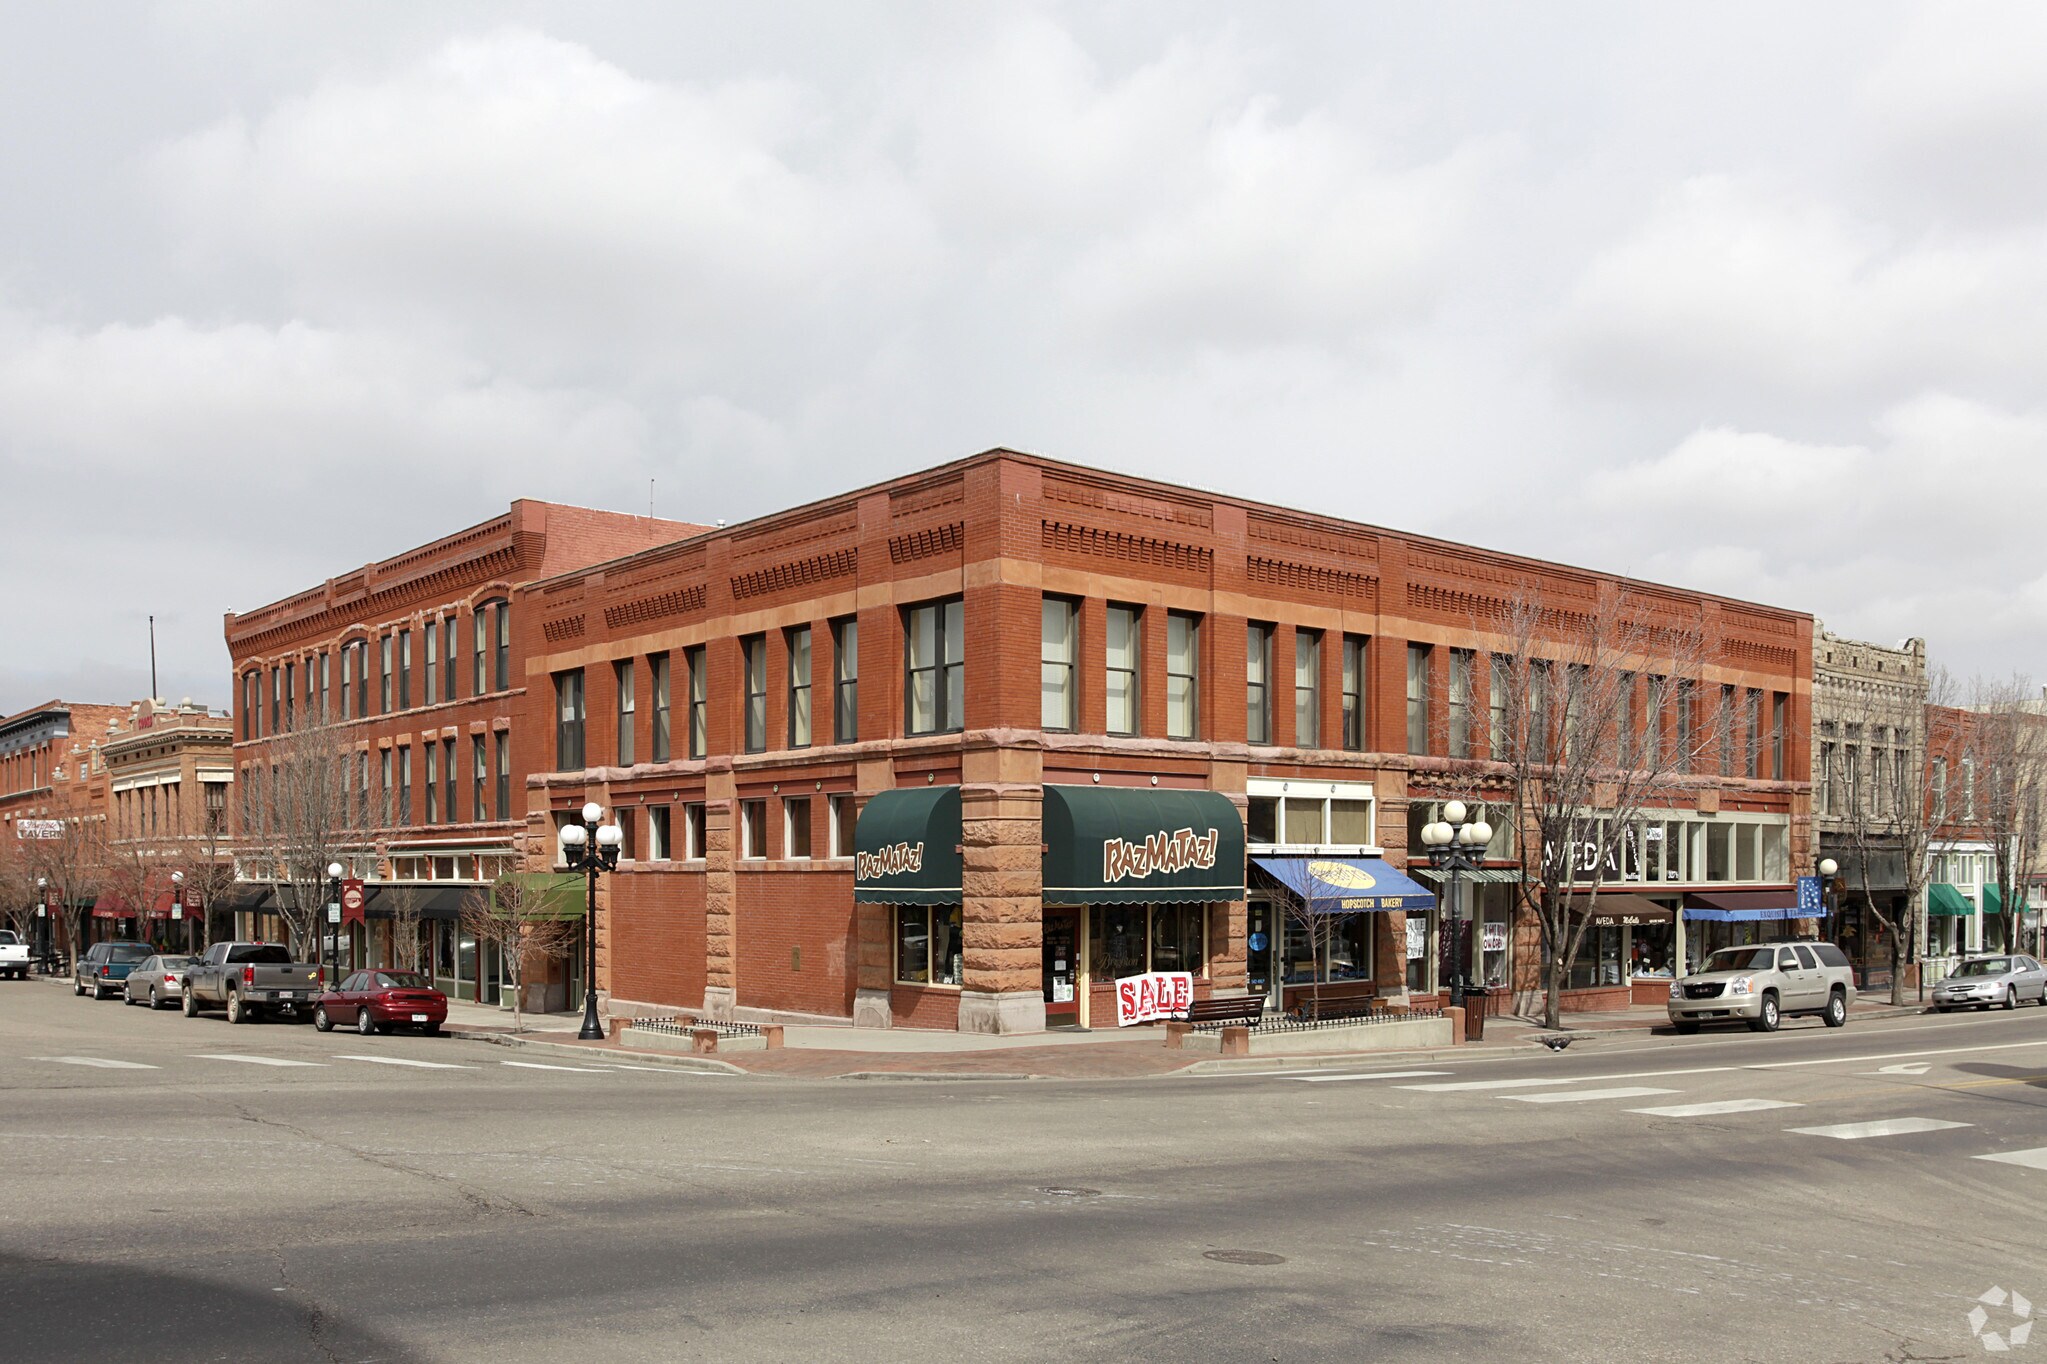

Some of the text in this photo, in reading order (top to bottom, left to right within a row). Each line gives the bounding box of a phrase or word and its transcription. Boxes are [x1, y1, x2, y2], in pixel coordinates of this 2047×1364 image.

[18, 829, 65, 838] TAVERN
[857, 841, 924, 881] RAZMATAZ!
[1104, 828, 1219, 883] RAZMATAZ!
[1341, 898, 1403, 909] HOPSCOTCH BAKERY
[1760, 909, 1786, 918] EXQUISIT
[1406, 920, 1425, 931] ALE
[1595, 916, 1615, 925] AVEDA
[1120, 976, 1190, 1020] SALE
